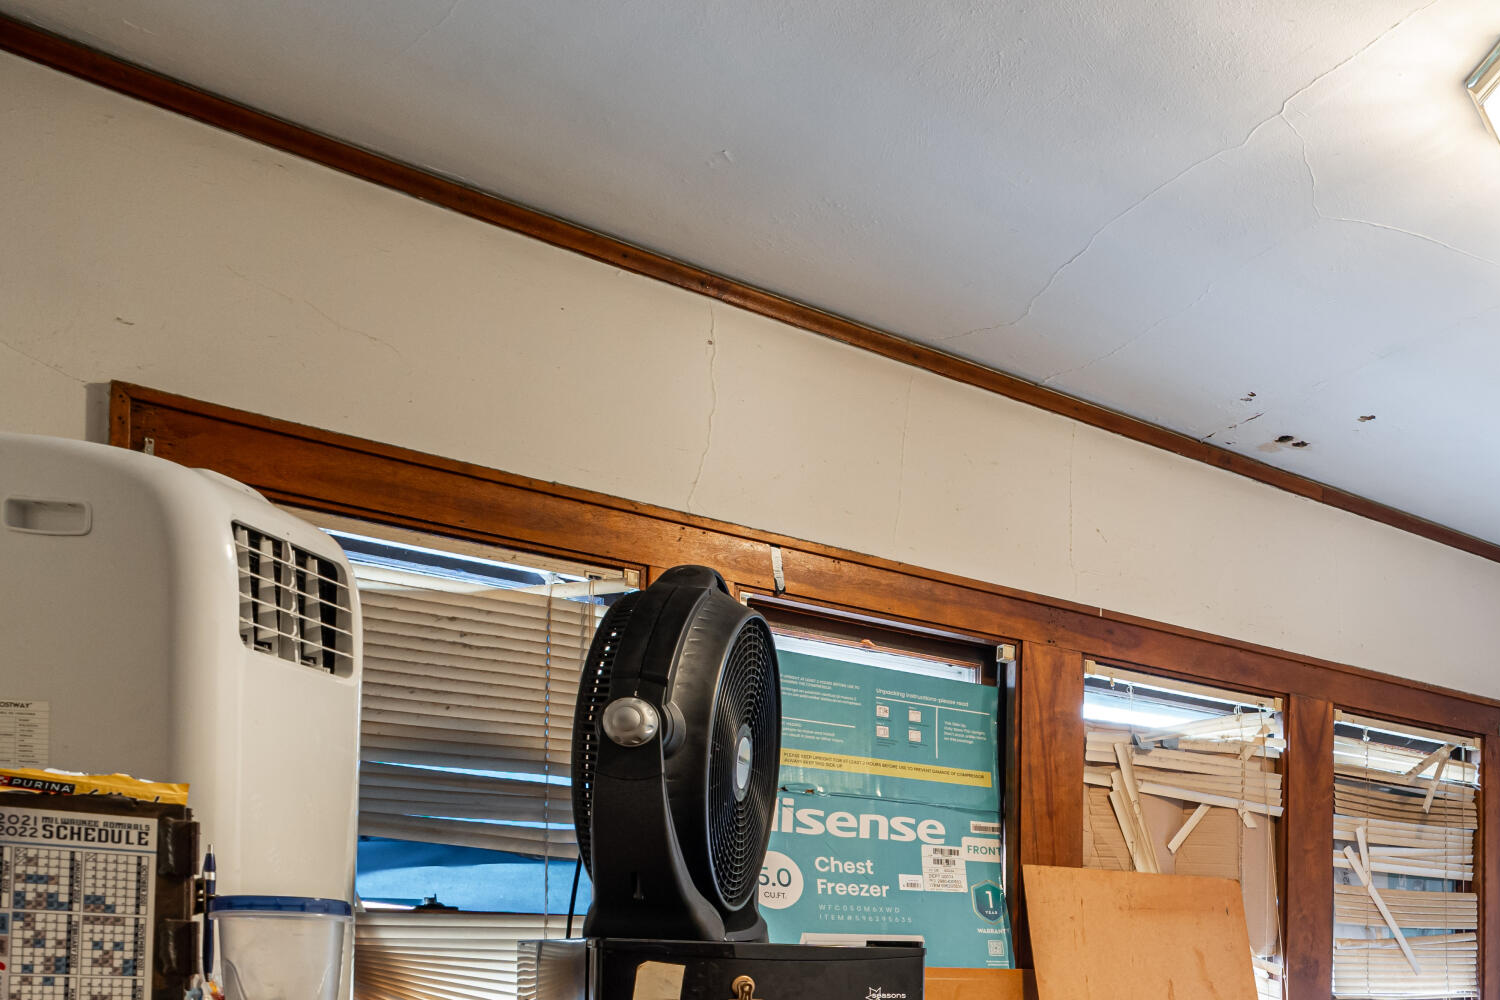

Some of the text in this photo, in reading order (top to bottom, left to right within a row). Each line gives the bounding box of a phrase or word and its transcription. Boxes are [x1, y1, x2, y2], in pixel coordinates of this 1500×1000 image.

[876, 688, 905, 697] Unpacking
[11, 778, 72, 794] PURINA
[0, 812, 150, 832] 2021 MILWAUKEE ADMIRALS
[0, 824, 149, 846] 2022 SCHEDULE
[968, 845, 1000, 856] FRONT
[815, 856, 874, 875] Chest
[758, 867, 792, 888] 5.0
[816, 878, 890, 898] Freezer
[985, 890, 994, 909] 1
